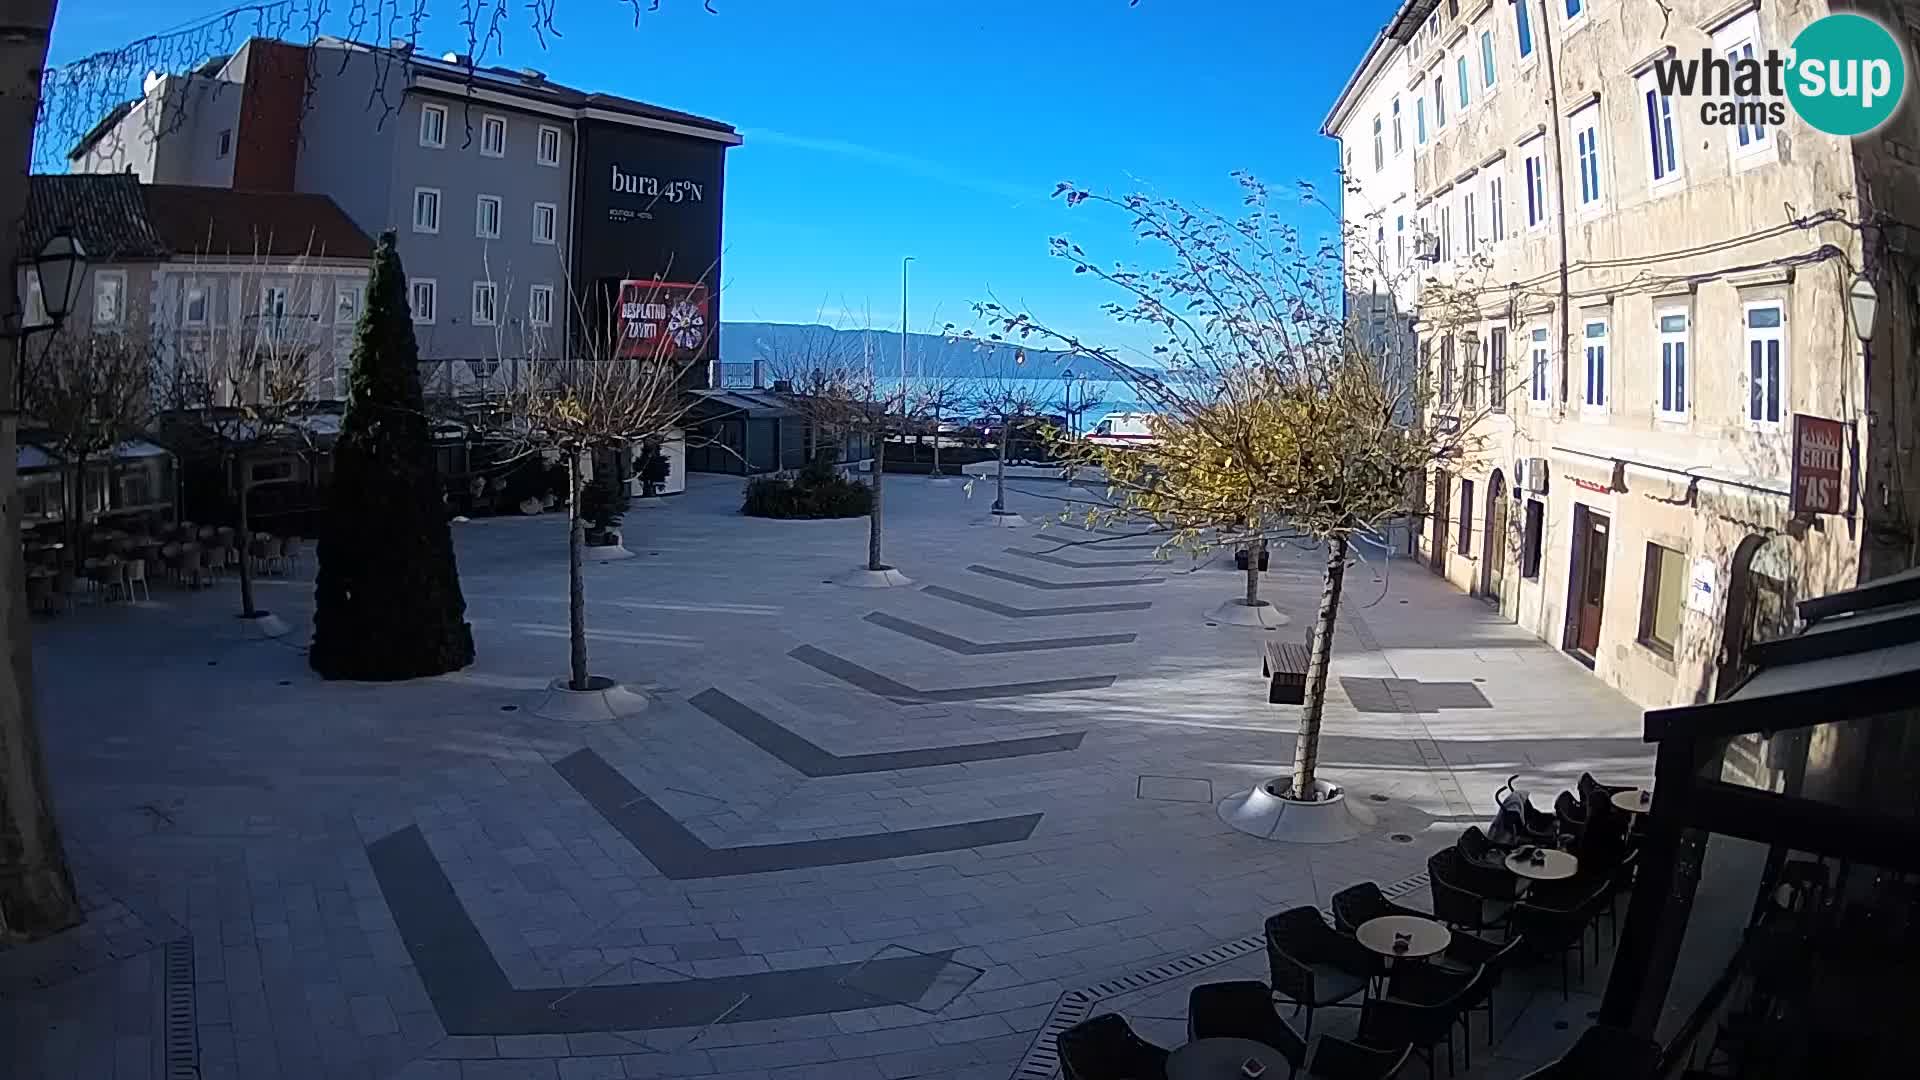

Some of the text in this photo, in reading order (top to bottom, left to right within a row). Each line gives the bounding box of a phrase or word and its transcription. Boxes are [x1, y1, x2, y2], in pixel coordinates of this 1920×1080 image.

[612, 165, 658, 196] bura
[622, 303, 666, 320] BESPLATNO
[1800, 448, 1840, 471] GRILL
